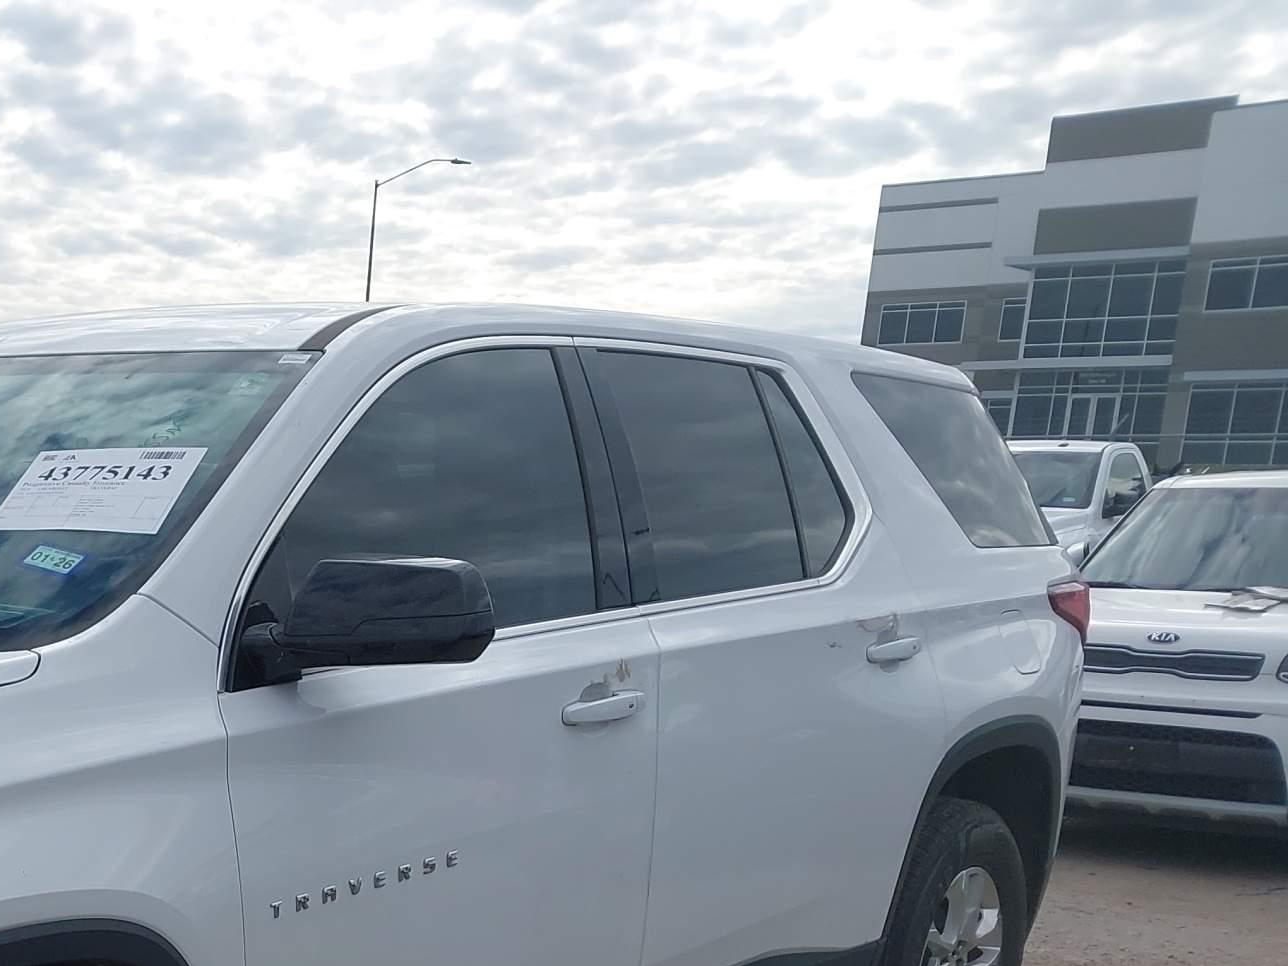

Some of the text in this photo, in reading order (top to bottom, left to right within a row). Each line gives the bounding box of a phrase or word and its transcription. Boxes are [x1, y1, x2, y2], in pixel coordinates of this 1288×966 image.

[38, 465, 173, 481] 43775143
[1151, 631, 1176, 641] KIA
[269, 849, 460, 919] TRAVERSE
